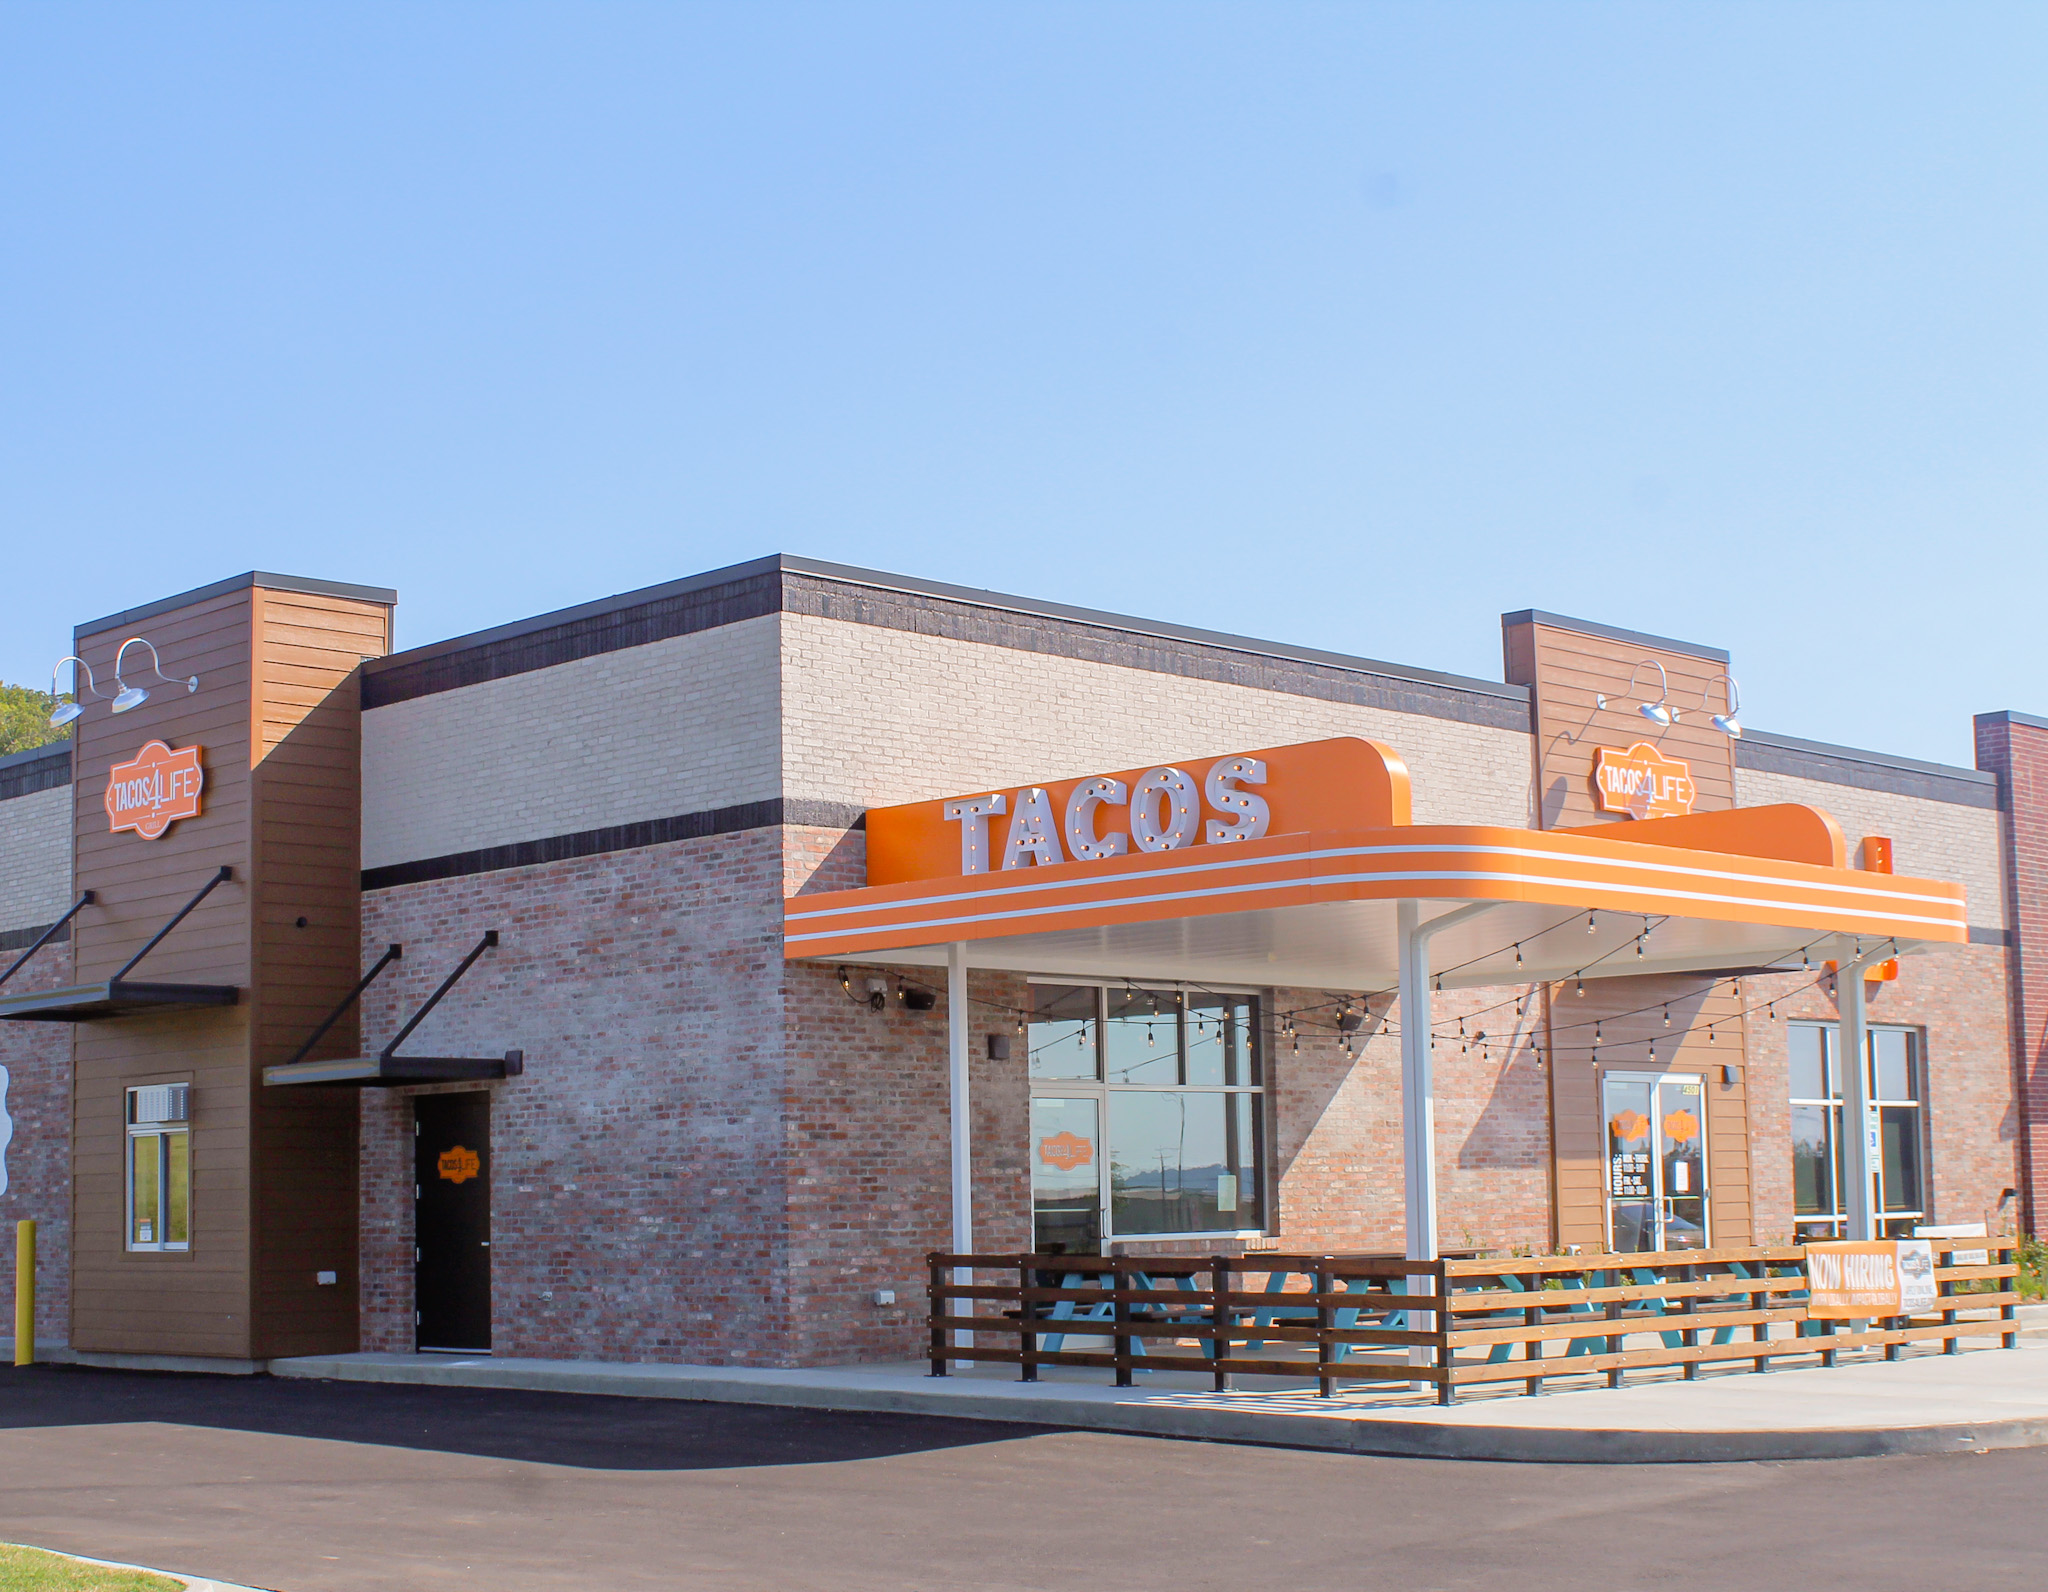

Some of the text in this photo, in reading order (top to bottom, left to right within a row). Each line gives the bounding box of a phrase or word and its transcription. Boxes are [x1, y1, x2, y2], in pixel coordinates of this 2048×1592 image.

[944, 756, 1270, 876] TACOS
[1613, 1154, 1624, 1195] HOURS:
[1808, 1253, 1895, 1290] NOW HIRING
